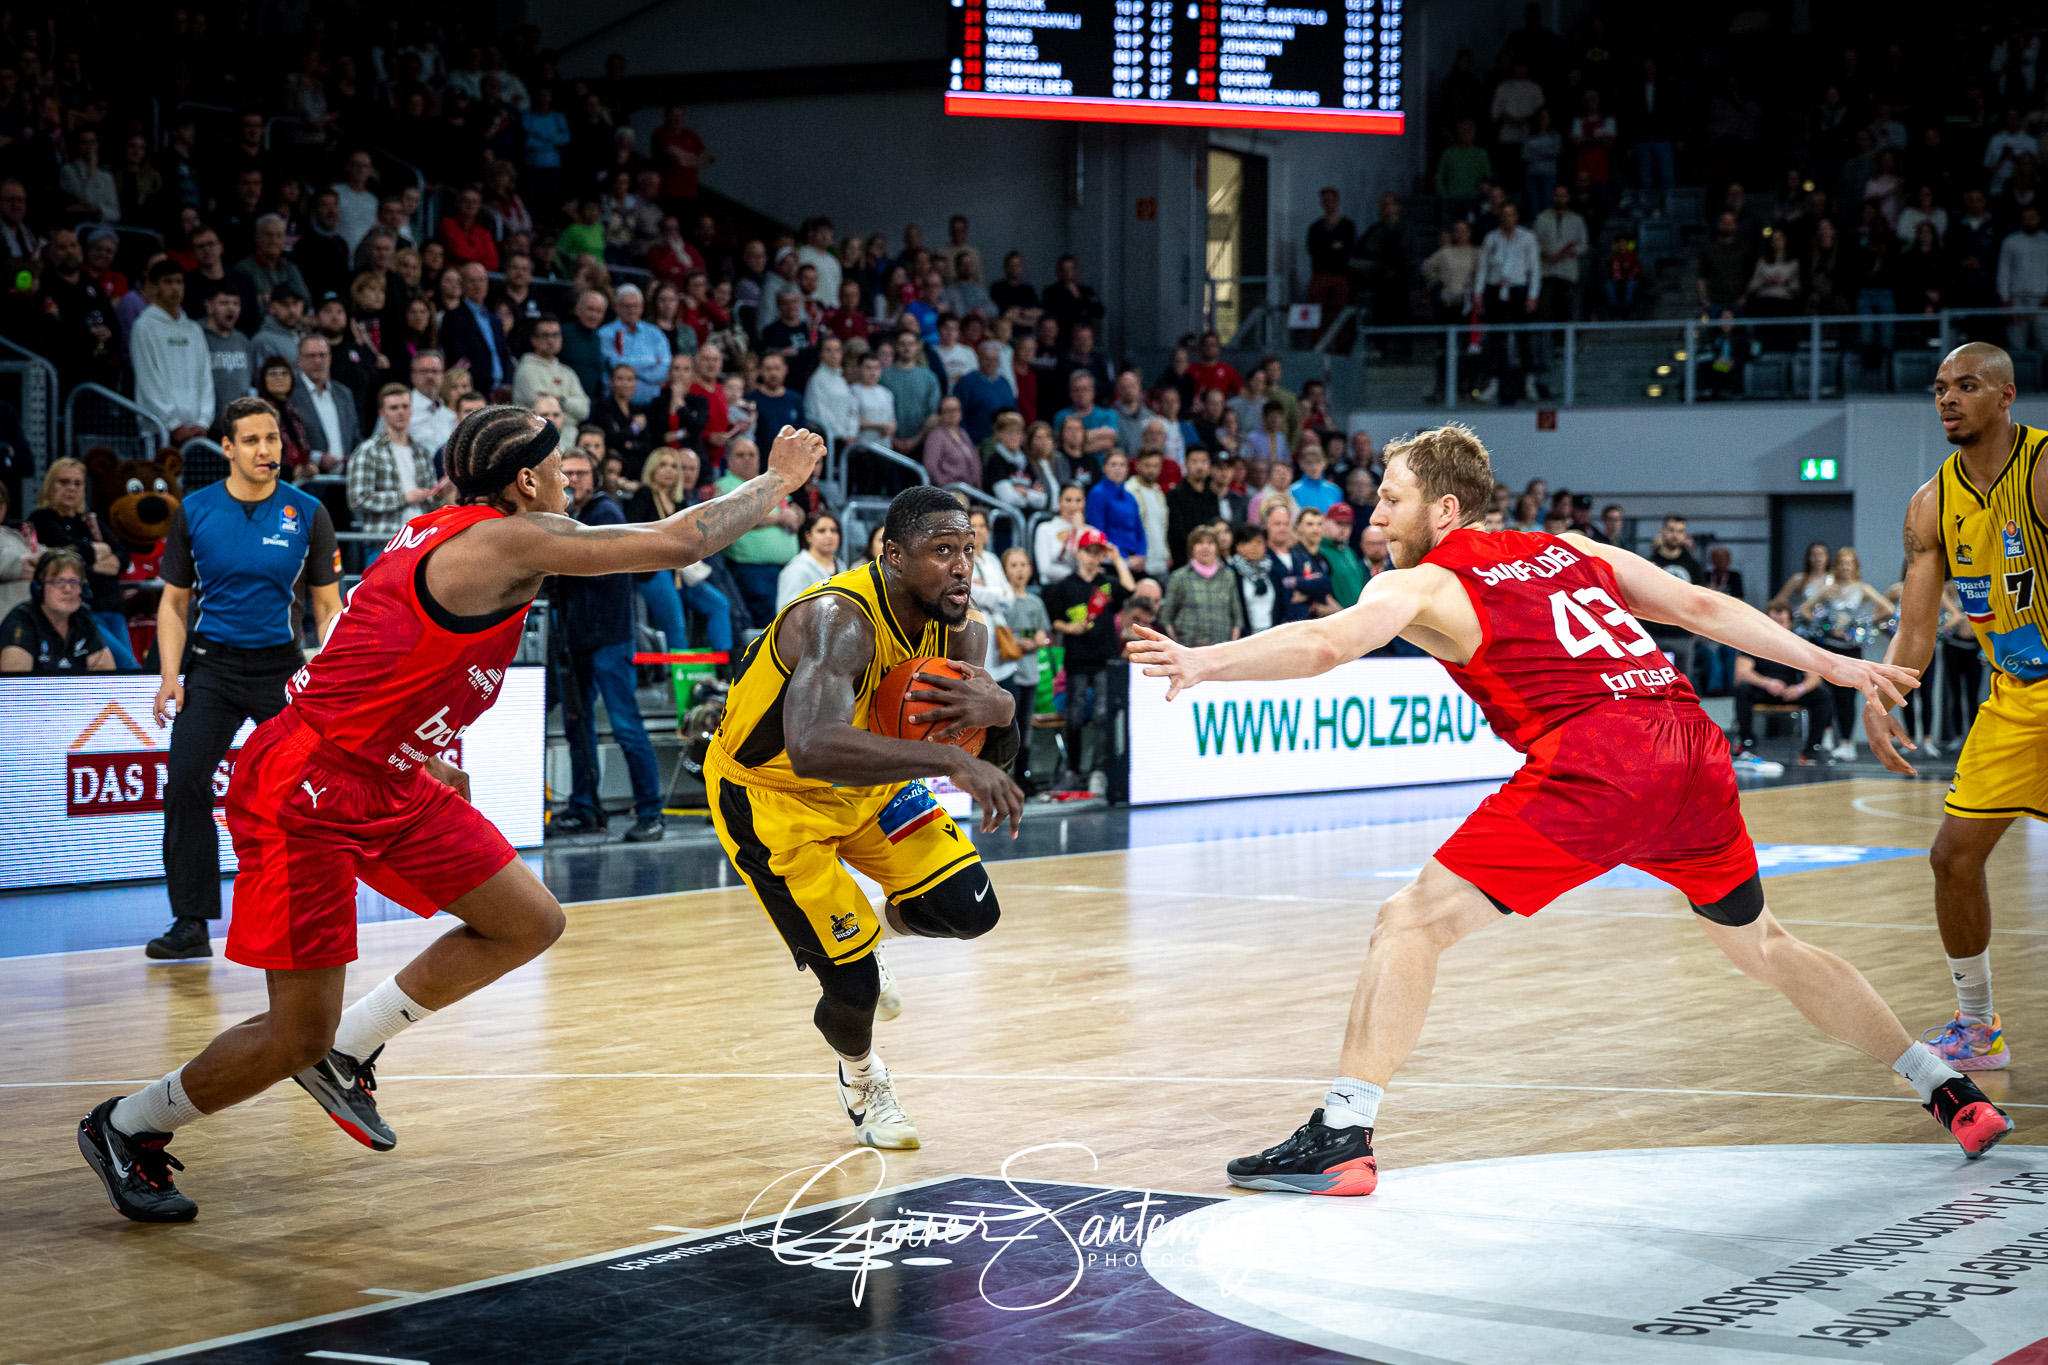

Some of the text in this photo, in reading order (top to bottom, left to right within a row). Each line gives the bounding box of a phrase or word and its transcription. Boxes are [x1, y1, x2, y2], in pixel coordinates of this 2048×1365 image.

[985, 26, 1033, 43] YOUNG
[1220, 38, 1282, 56] JOHNSON
[985, 76, 1073, 95] SENGFELDER
[1953, 580, 1991, 590] Sparda
[2003, 567, 2035, 613] 7
[1548, 586, 1657, 658] 43
[1600, 666, 1678, 692] brose
[1192, 694, 1500, 757] WWW.HOLZBAU-
[71, 764, 144, 804] DAS
[1632, 1192, 2046, 1337] Automobilindustrie
[1798, 1279, 2019, 1347] Partner
